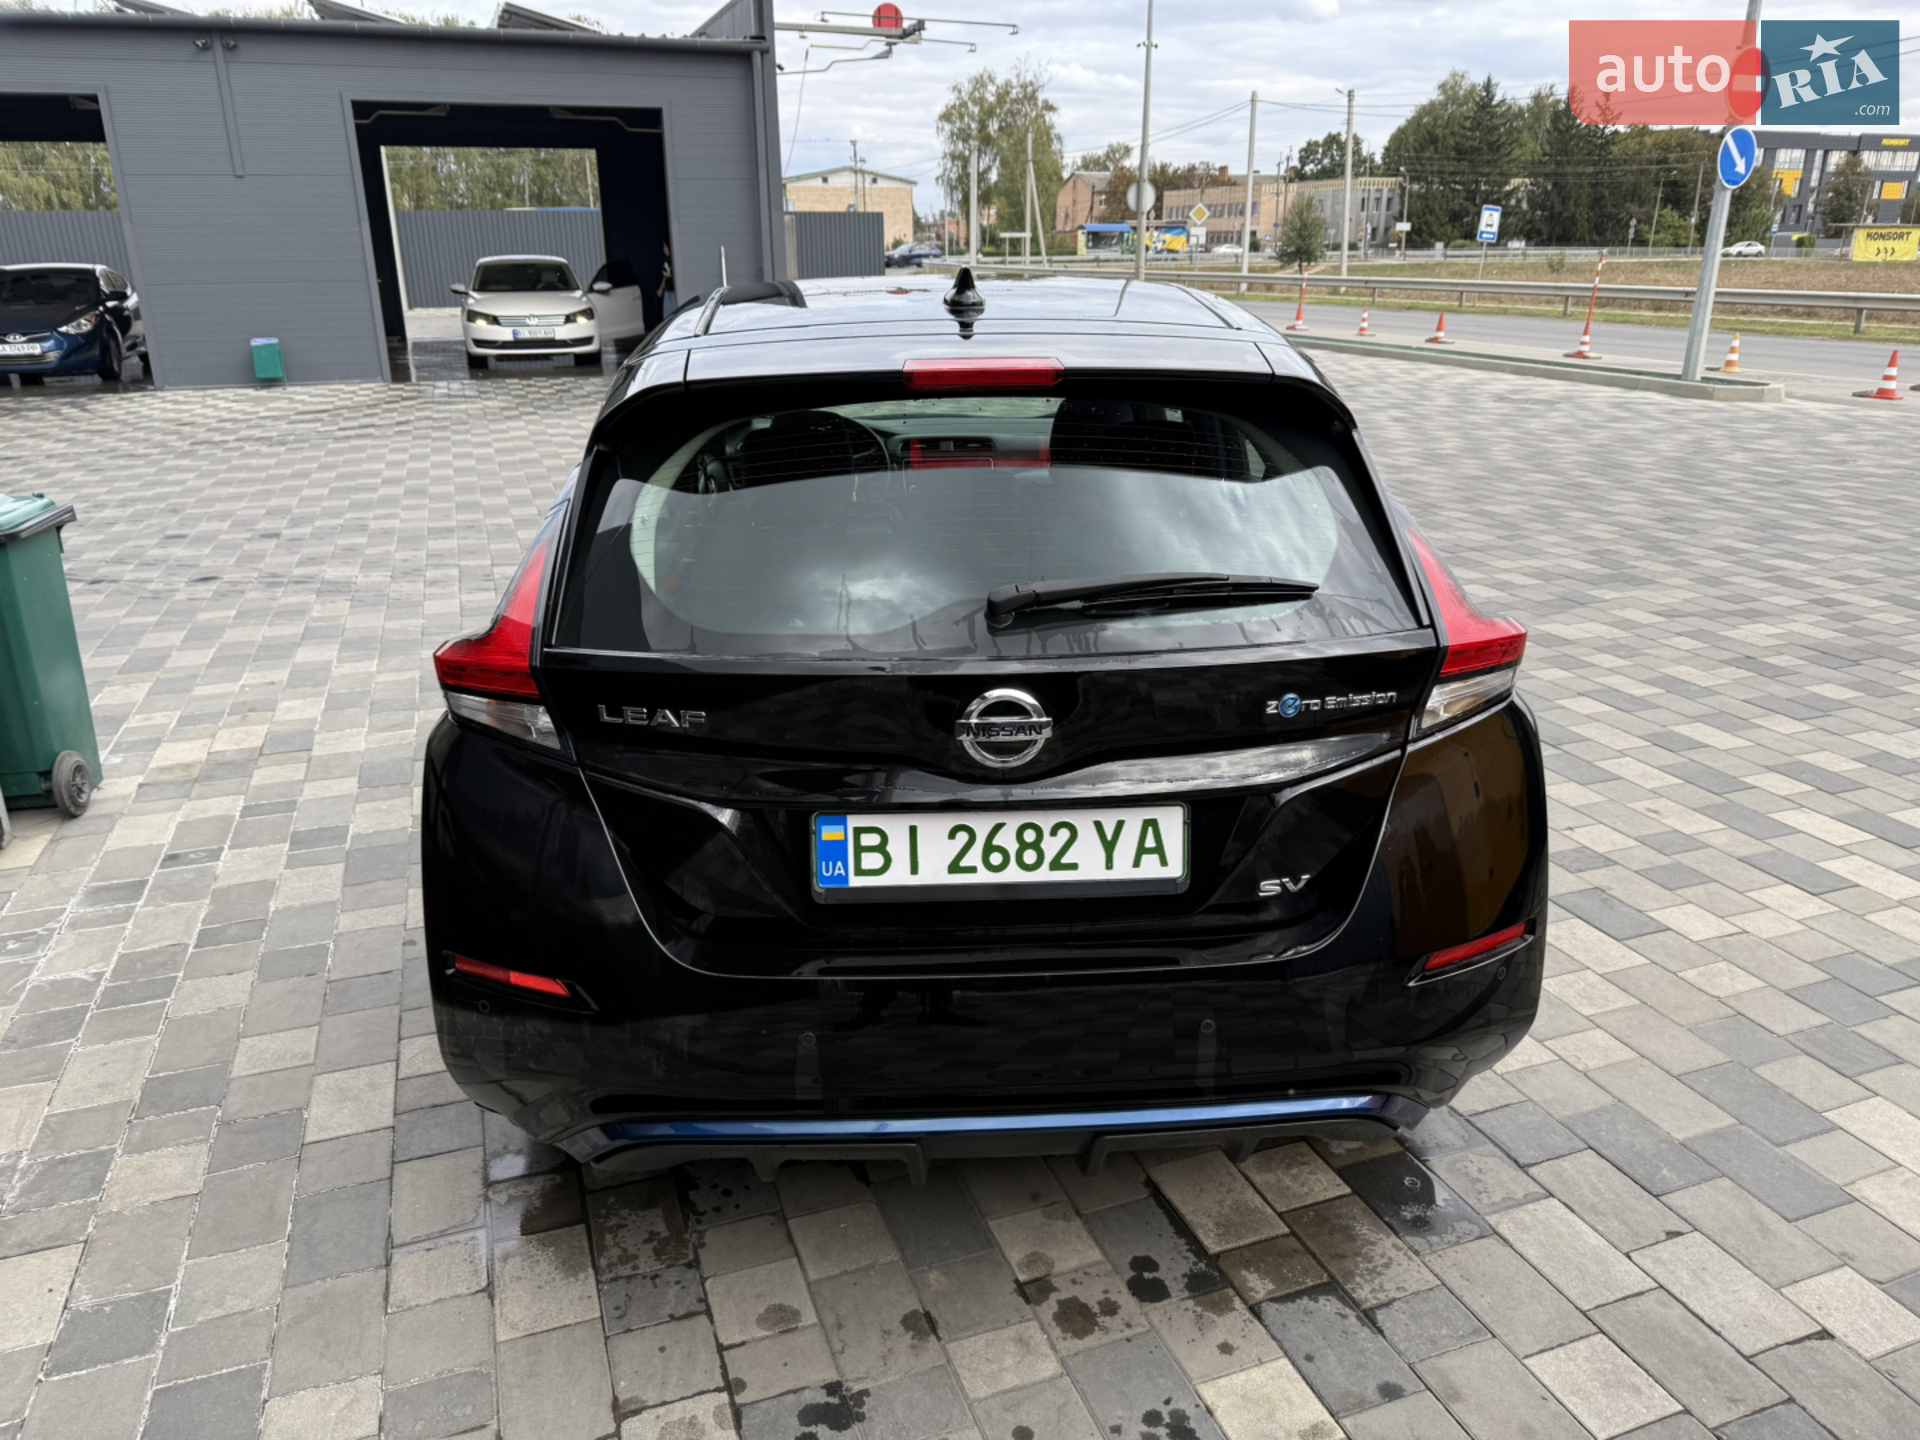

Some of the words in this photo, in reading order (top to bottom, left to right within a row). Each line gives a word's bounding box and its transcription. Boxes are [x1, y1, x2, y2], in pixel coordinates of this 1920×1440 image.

[1866, 231, 1912, 241] KONSORT
[597, 704, 706, 728] LEAF
[965, 724, 1043, 738] NISSAN
[852, 824, 919, 877] BI
[947, 820, 1079, 875] 2682
[1092, 817, 1170, 871] YA
[821, 860, 846, 877] UA
[1258, 874, 1311, 897] SV
